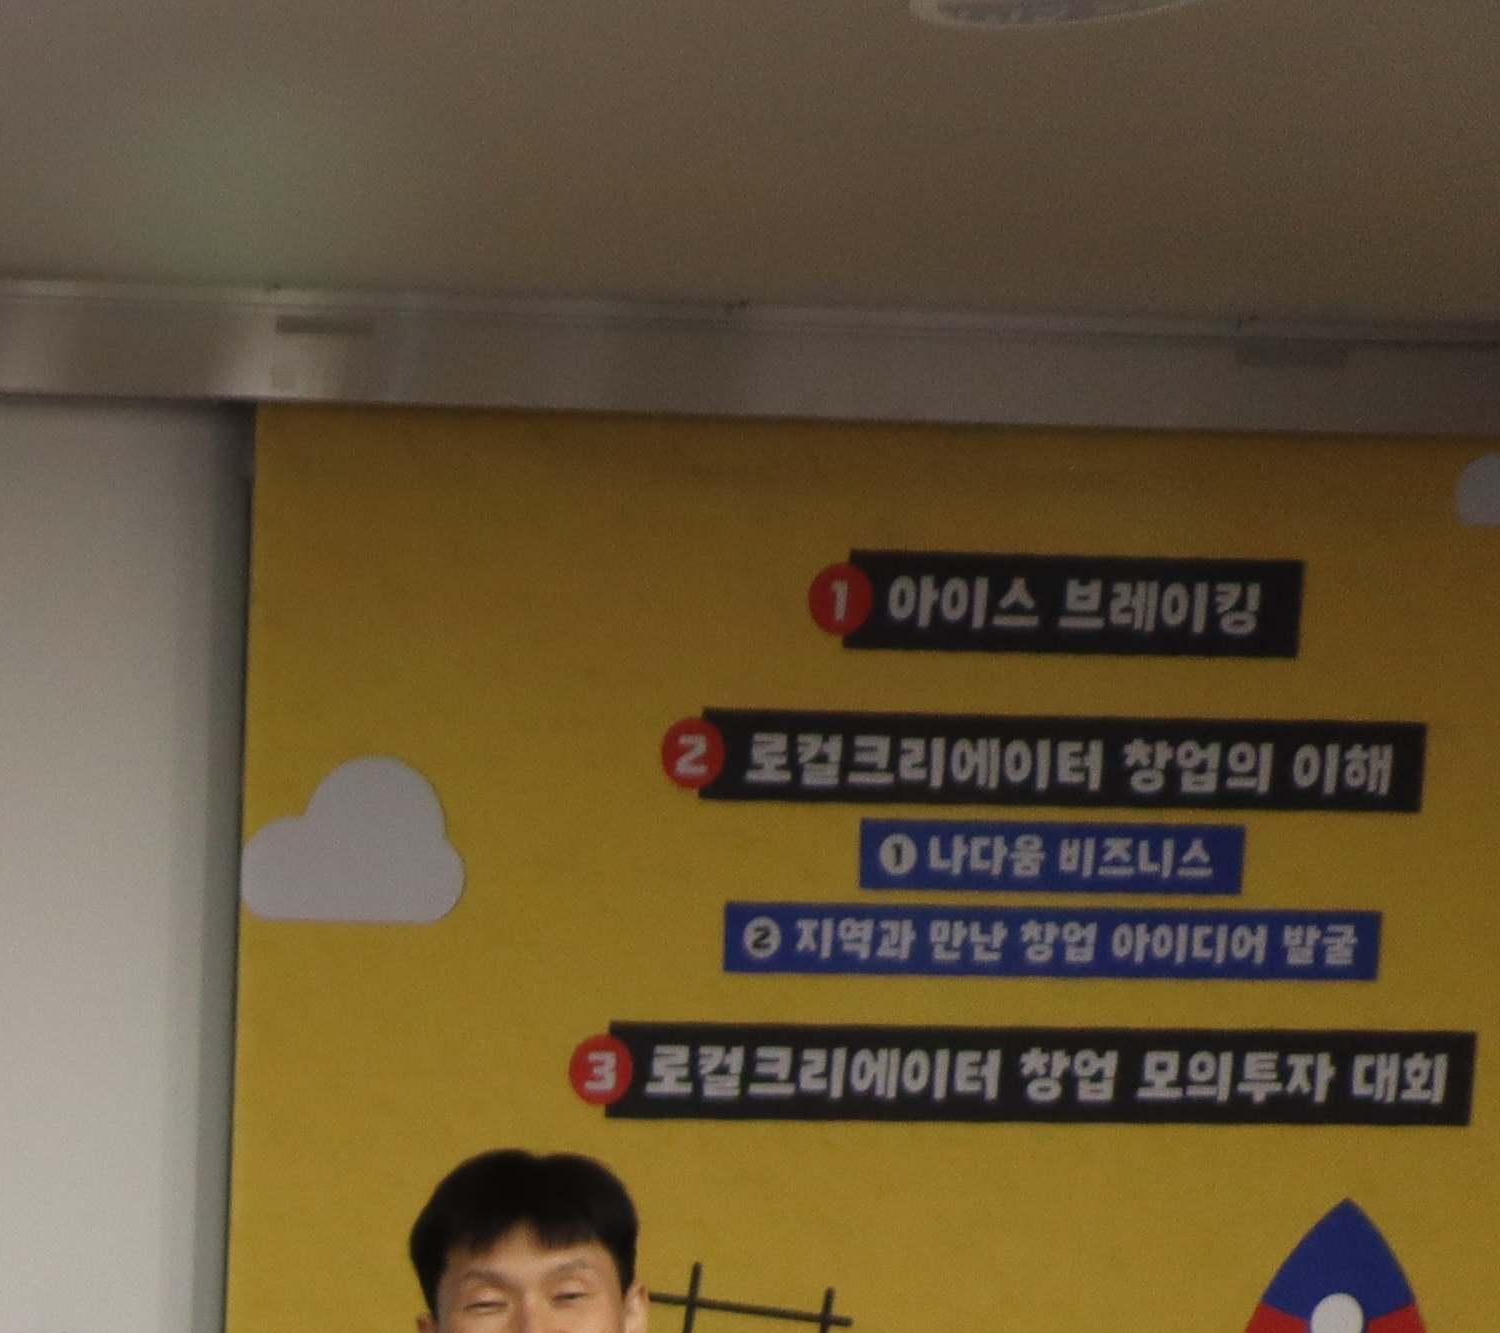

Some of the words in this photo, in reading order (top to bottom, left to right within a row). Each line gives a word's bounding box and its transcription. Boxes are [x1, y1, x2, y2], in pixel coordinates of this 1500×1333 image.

[888, 575, 1040, 629] 아이스
[1058, 578, 1262, 635] 브레이킹
[674, 734, 709, 776] 2
[744, 731, 1102, 791] 로컬크리에이터
[1123, 738, 1274, 794] 창업의
[1292, 742, 1394, 796] 이해
[930, 834, 1045, 878] 나다움
[1058, 836, 1213, 879] 비즈니스
[795, 917, 917, 962] 지역과
[928, 919, 1007, 963] 만난
[1020, 920, 1098, 964] 창업
[1112, 922, 1267, 966] 아이디어
[1282, 922, 1359, 968] 발굴
[584, 1051, 617, 1091] 3
[645, 1043, 1002, 1102] 로컬크리에이터
[1018, 1046, 1118, 1104] 창업
[1135, 1050, 1336, 1106] 모의투자
[1351, 1051, 1448, 1107] 대회
